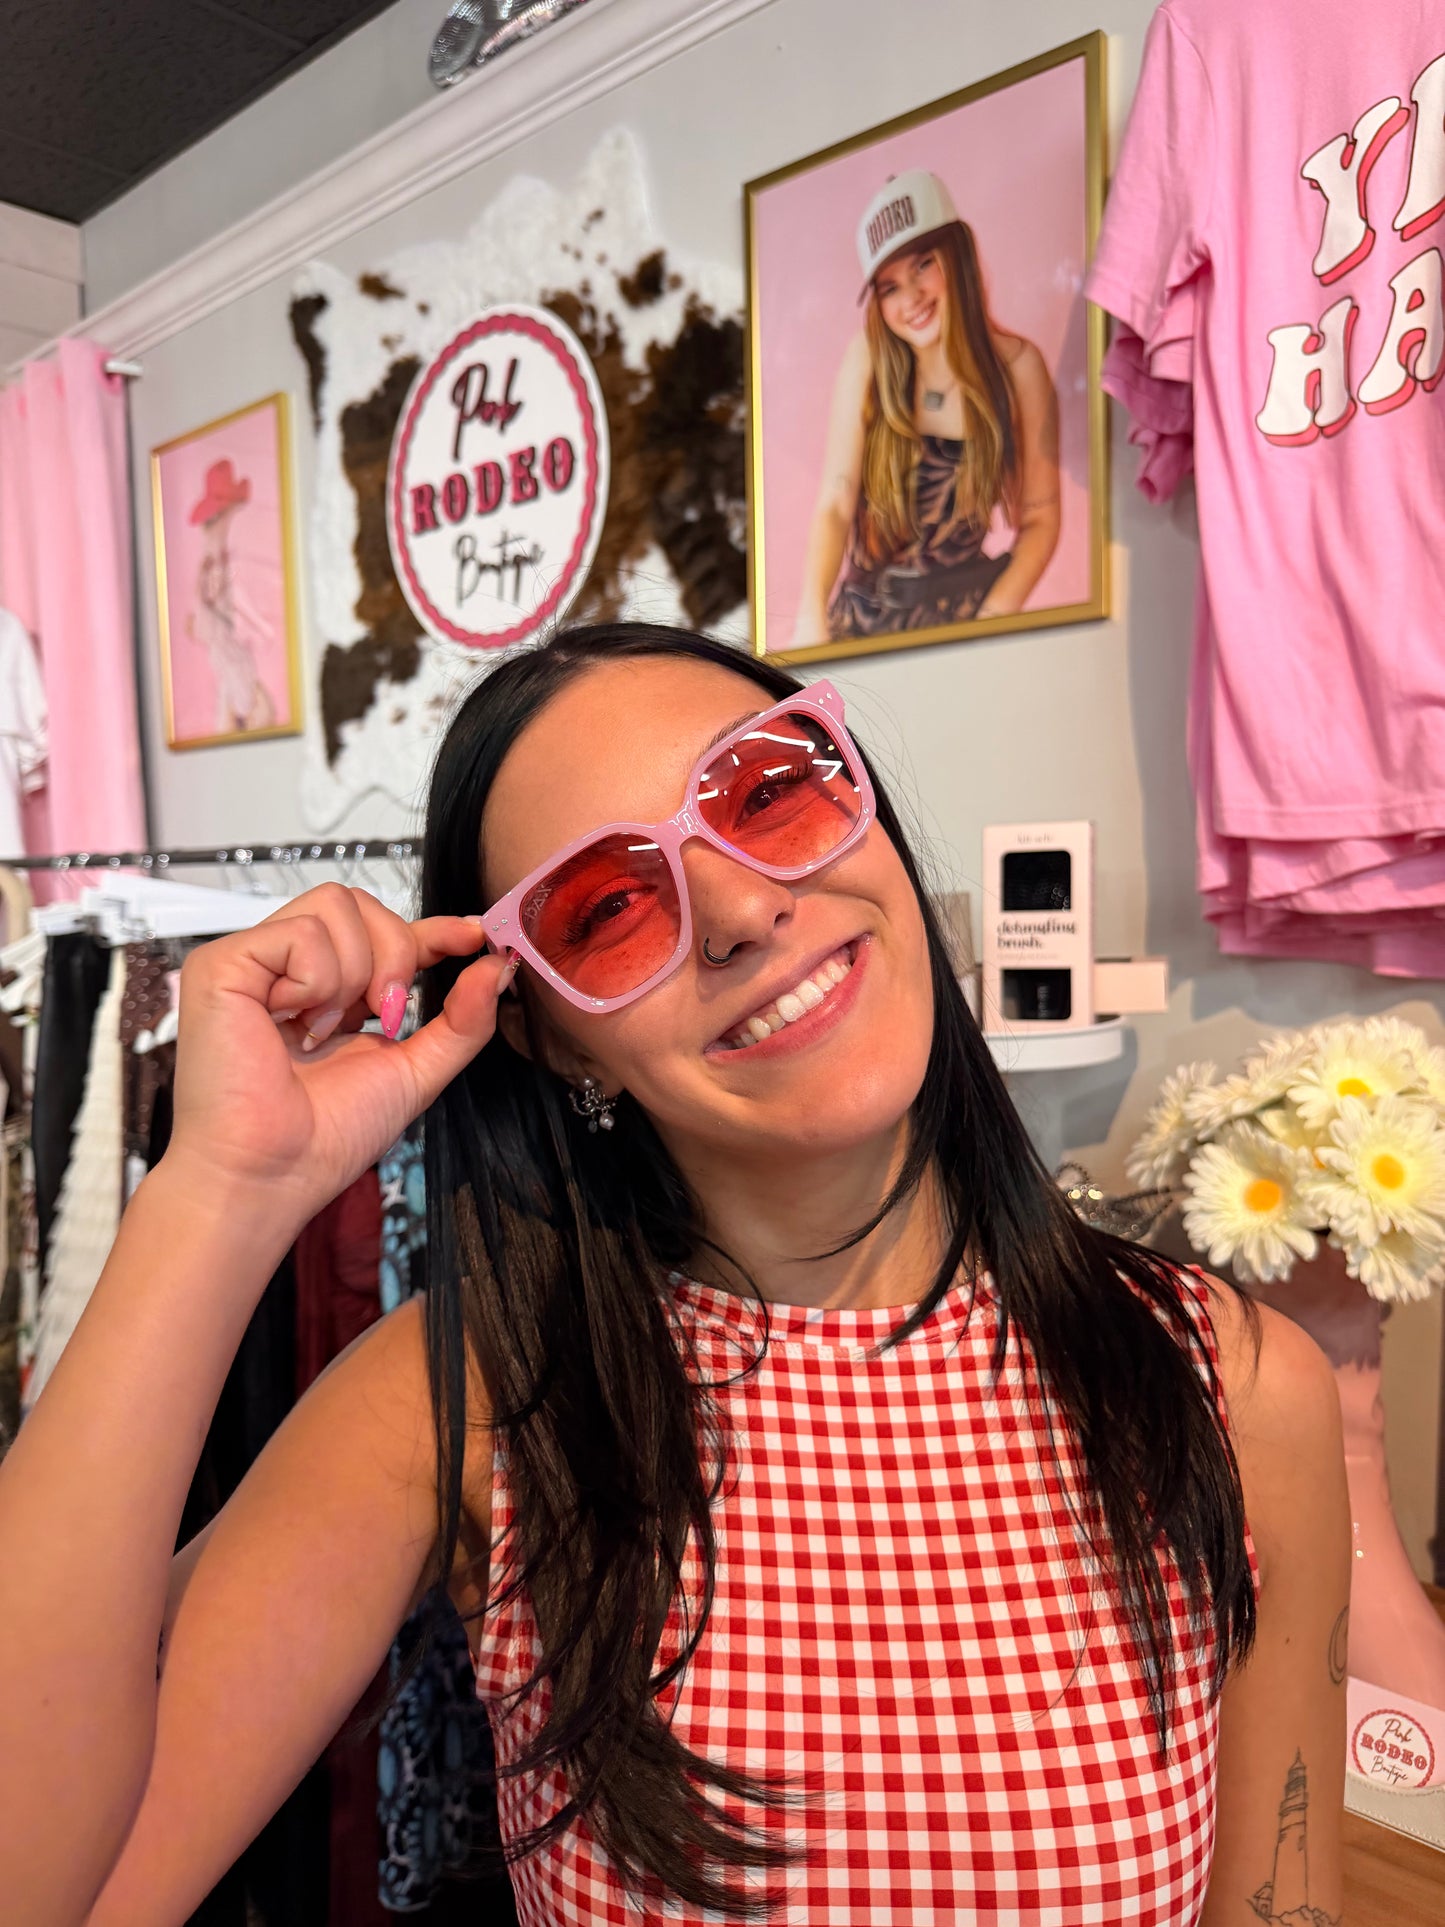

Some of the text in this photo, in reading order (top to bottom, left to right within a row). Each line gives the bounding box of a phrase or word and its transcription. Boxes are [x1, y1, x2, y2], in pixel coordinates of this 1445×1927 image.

[408, 436, 576, 536] RODEO
[996, 919, 1076, 936] detangling
[1382, 1718, 1413, 1743] Pink
[1360, 1732, 1428, 1771] RODEO
[1371, 1755, 1408, 1785] Boutique
